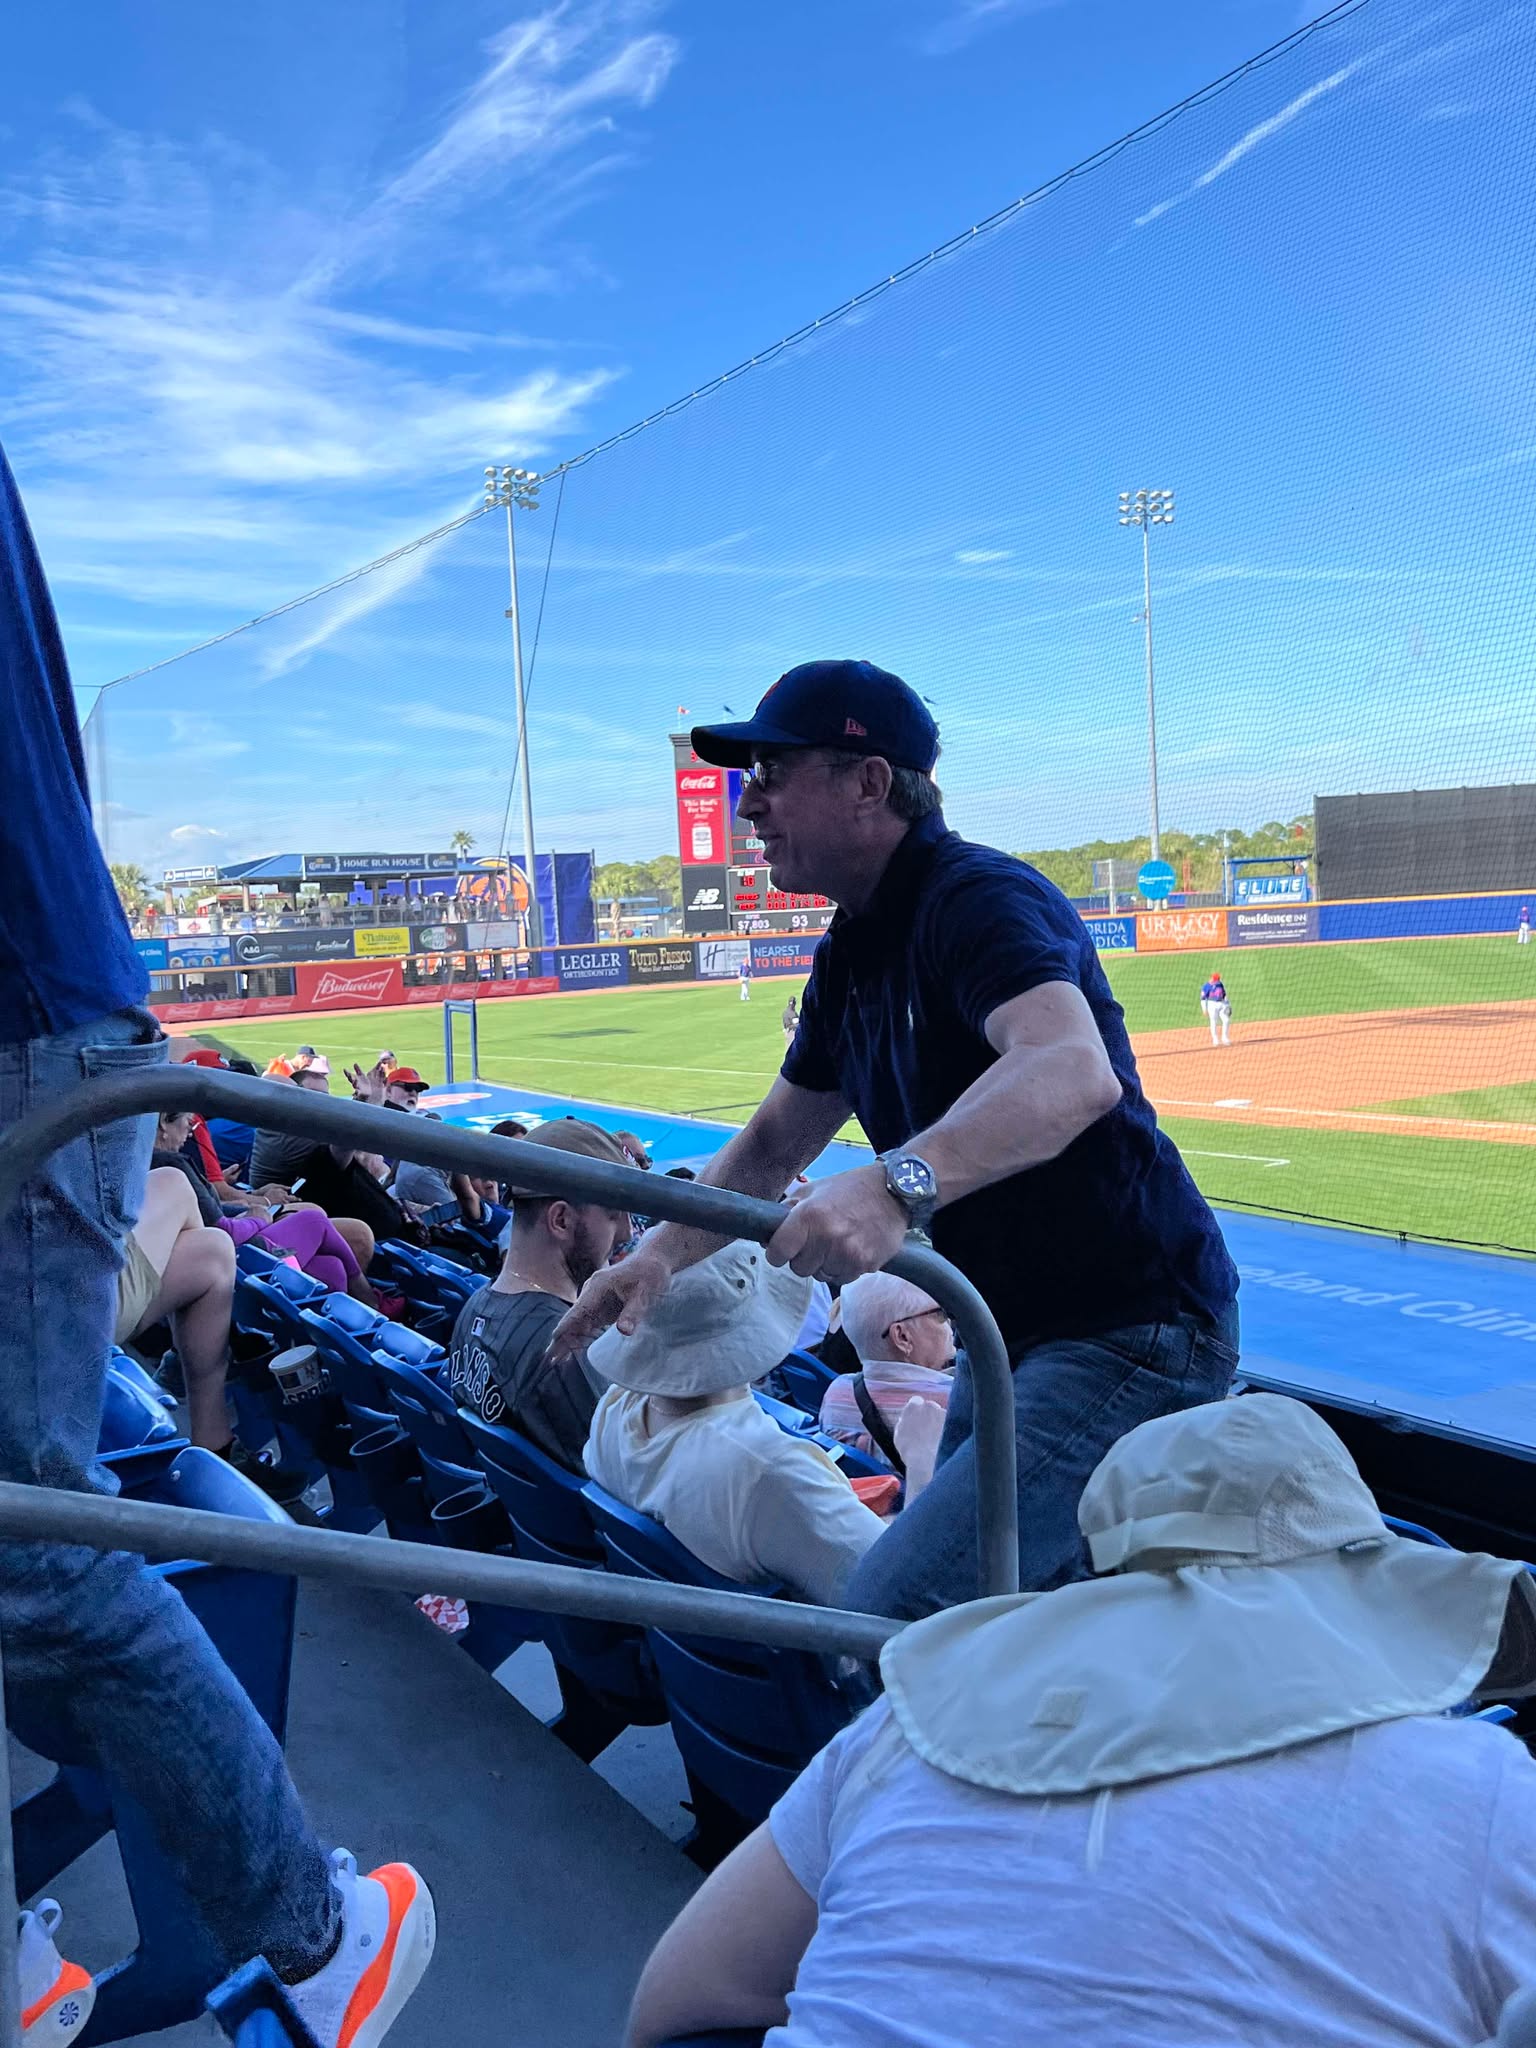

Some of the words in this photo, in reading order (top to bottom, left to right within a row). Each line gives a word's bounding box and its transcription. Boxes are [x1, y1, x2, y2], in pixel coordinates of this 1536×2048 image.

[343, 859, 368, 868] HOME
[371, 858, 390, 867] RUN
[392, 857, 422, 866] HOUSE
[1238, 879, 1302, 895] ELITE
[738, 920, 770, 931] $7,803
[791, 915, 808, 927] 93
[1237, 913, 1293, 926] Residence
[754, 944, 800, 957] NEAREST
[560, 952, 622, 971] LEGLER
[755, 958, 770, 969] TO
[771, 957, 793, 968] THE
[319, 979, 386, 995] Budweiser
